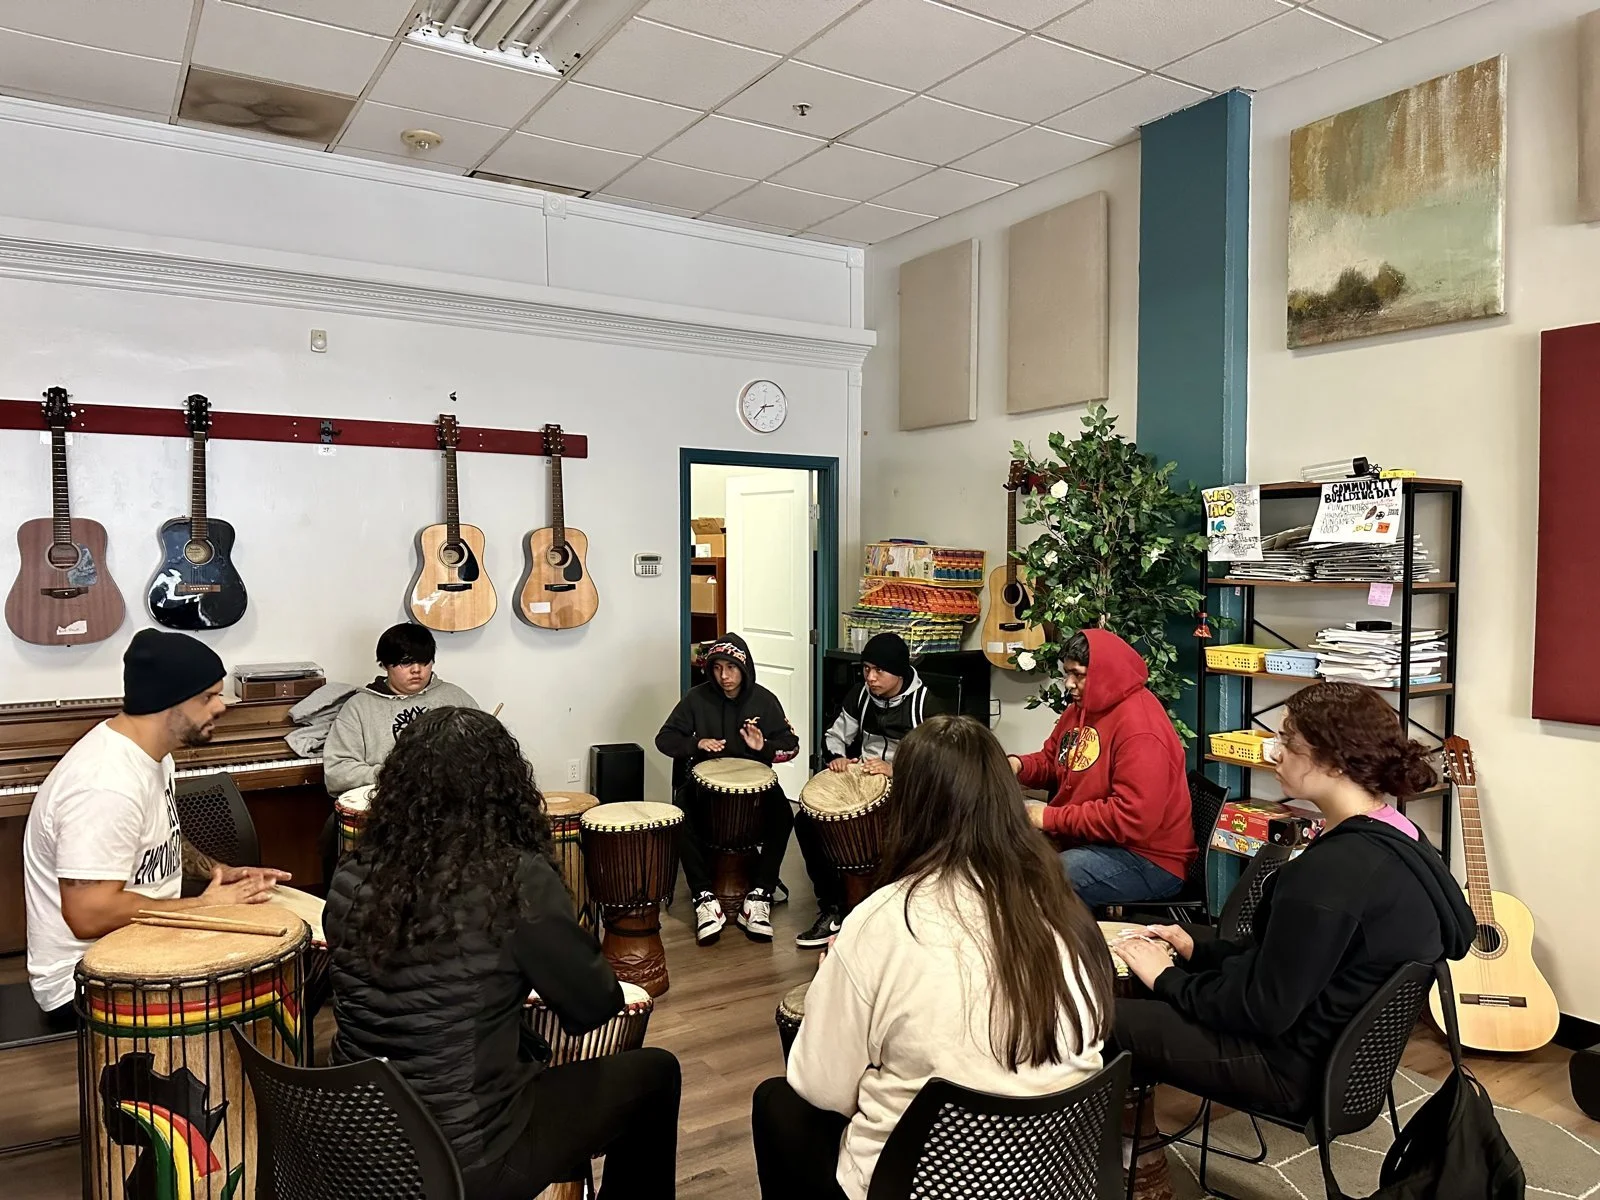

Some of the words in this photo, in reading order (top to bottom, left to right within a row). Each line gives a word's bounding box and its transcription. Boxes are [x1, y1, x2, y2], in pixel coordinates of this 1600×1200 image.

[1332, 479, 1393, 494] COMMUNITY
[1203, 488, 1235, 503] WED
[1324, 489, 1375, 503] BUILDING
[1377, 488, 1397, 498] DAY
[1208, 502, 1235, 518] AUG
[1211, 520, 1226, 533] 16
[1229, 745, 1234, 754] 5
